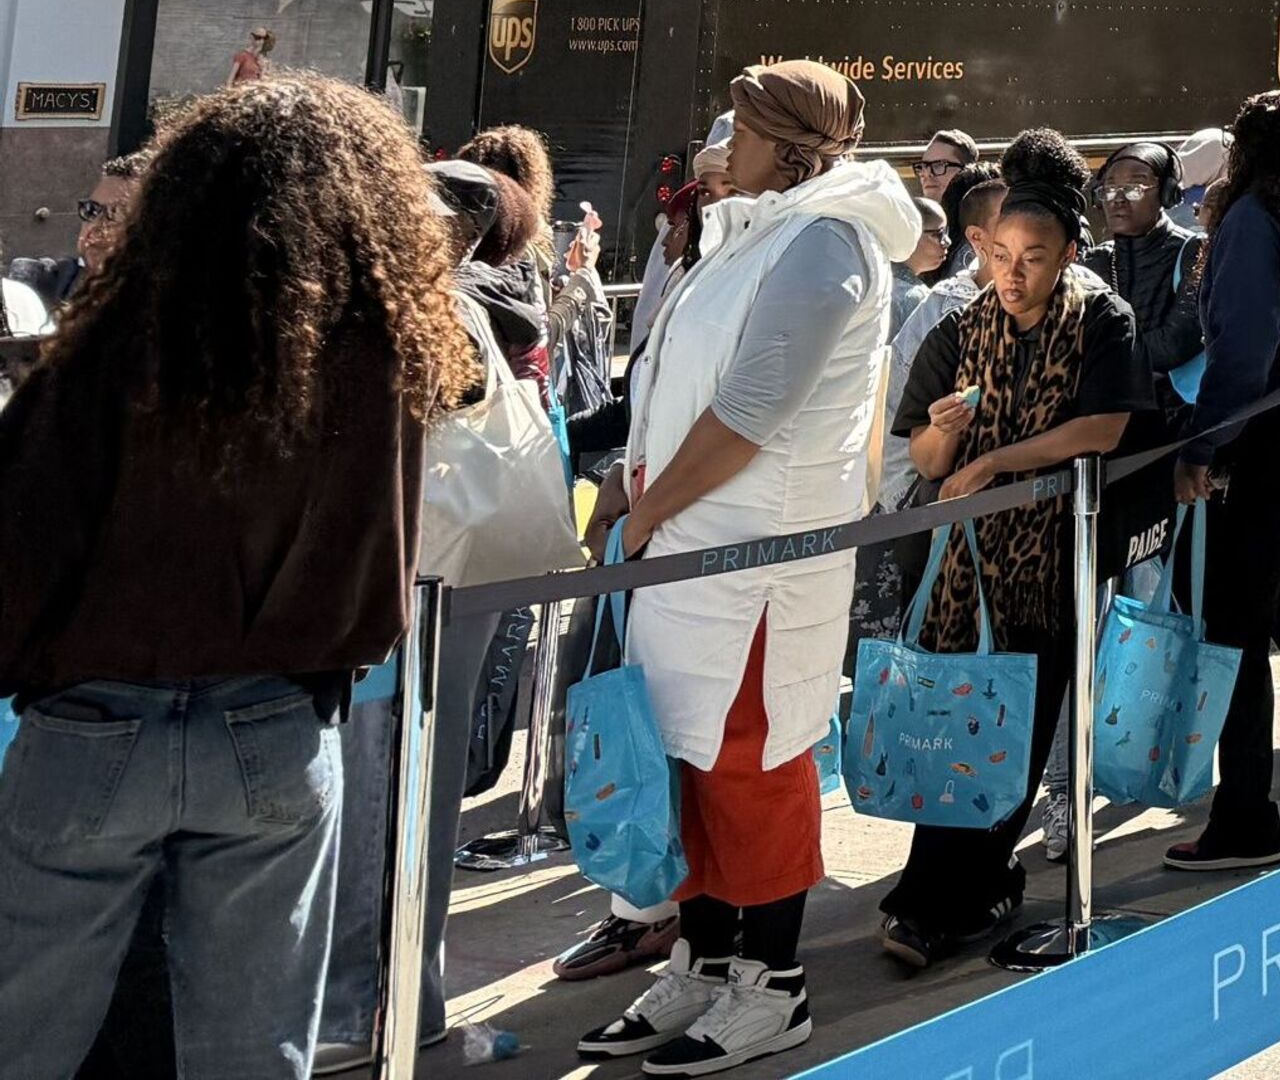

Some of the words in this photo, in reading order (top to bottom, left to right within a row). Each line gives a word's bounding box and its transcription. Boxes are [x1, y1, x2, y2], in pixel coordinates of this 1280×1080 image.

[577, 17, 596, 31] 800
[598, 17, 619, 31] PICK
[622, 16, 641, 31] UPS
[492, 16, 533, 61] ups
[569, 40, 638, 57] www.ups.com
[881, 55, 964, 80] Services
[1125, 518, 1168, 569] PAIGE
[899, 732, 953, 751] PRIMARK
